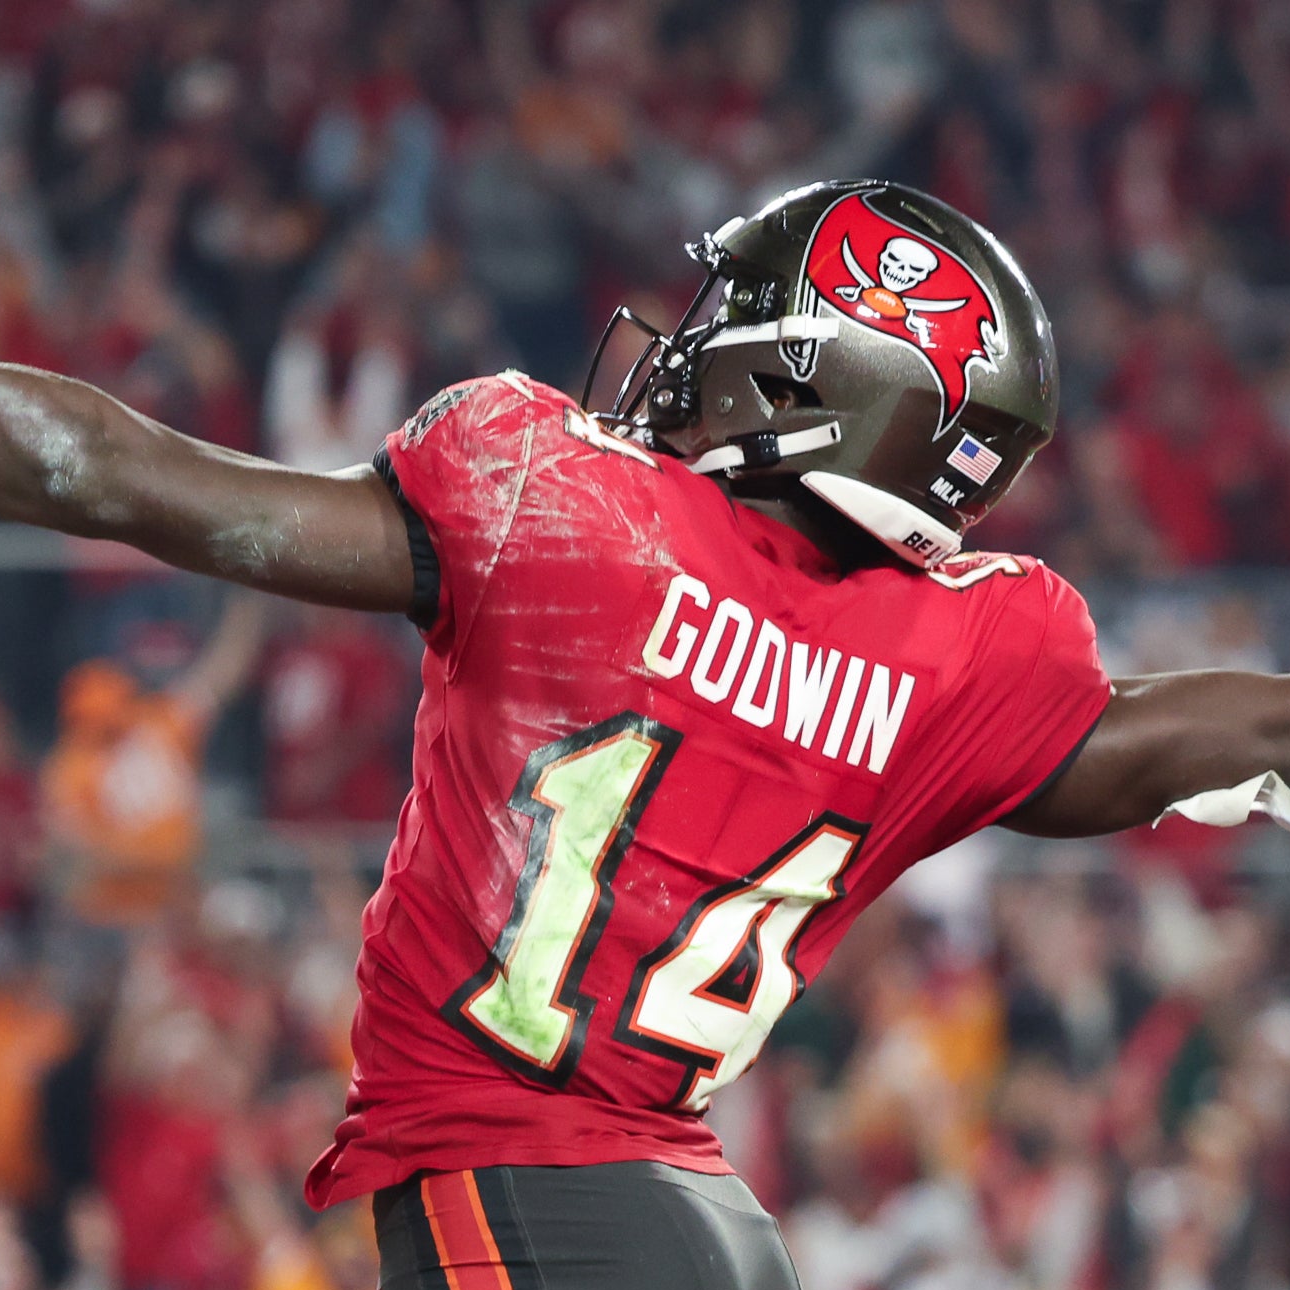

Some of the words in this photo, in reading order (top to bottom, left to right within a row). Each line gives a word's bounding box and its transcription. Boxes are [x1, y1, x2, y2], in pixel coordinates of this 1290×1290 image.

[930, 477, 965, 507] MLK
[641, 572, 916, 775] GODWIN
[441, 710, 872, 1112] 14
